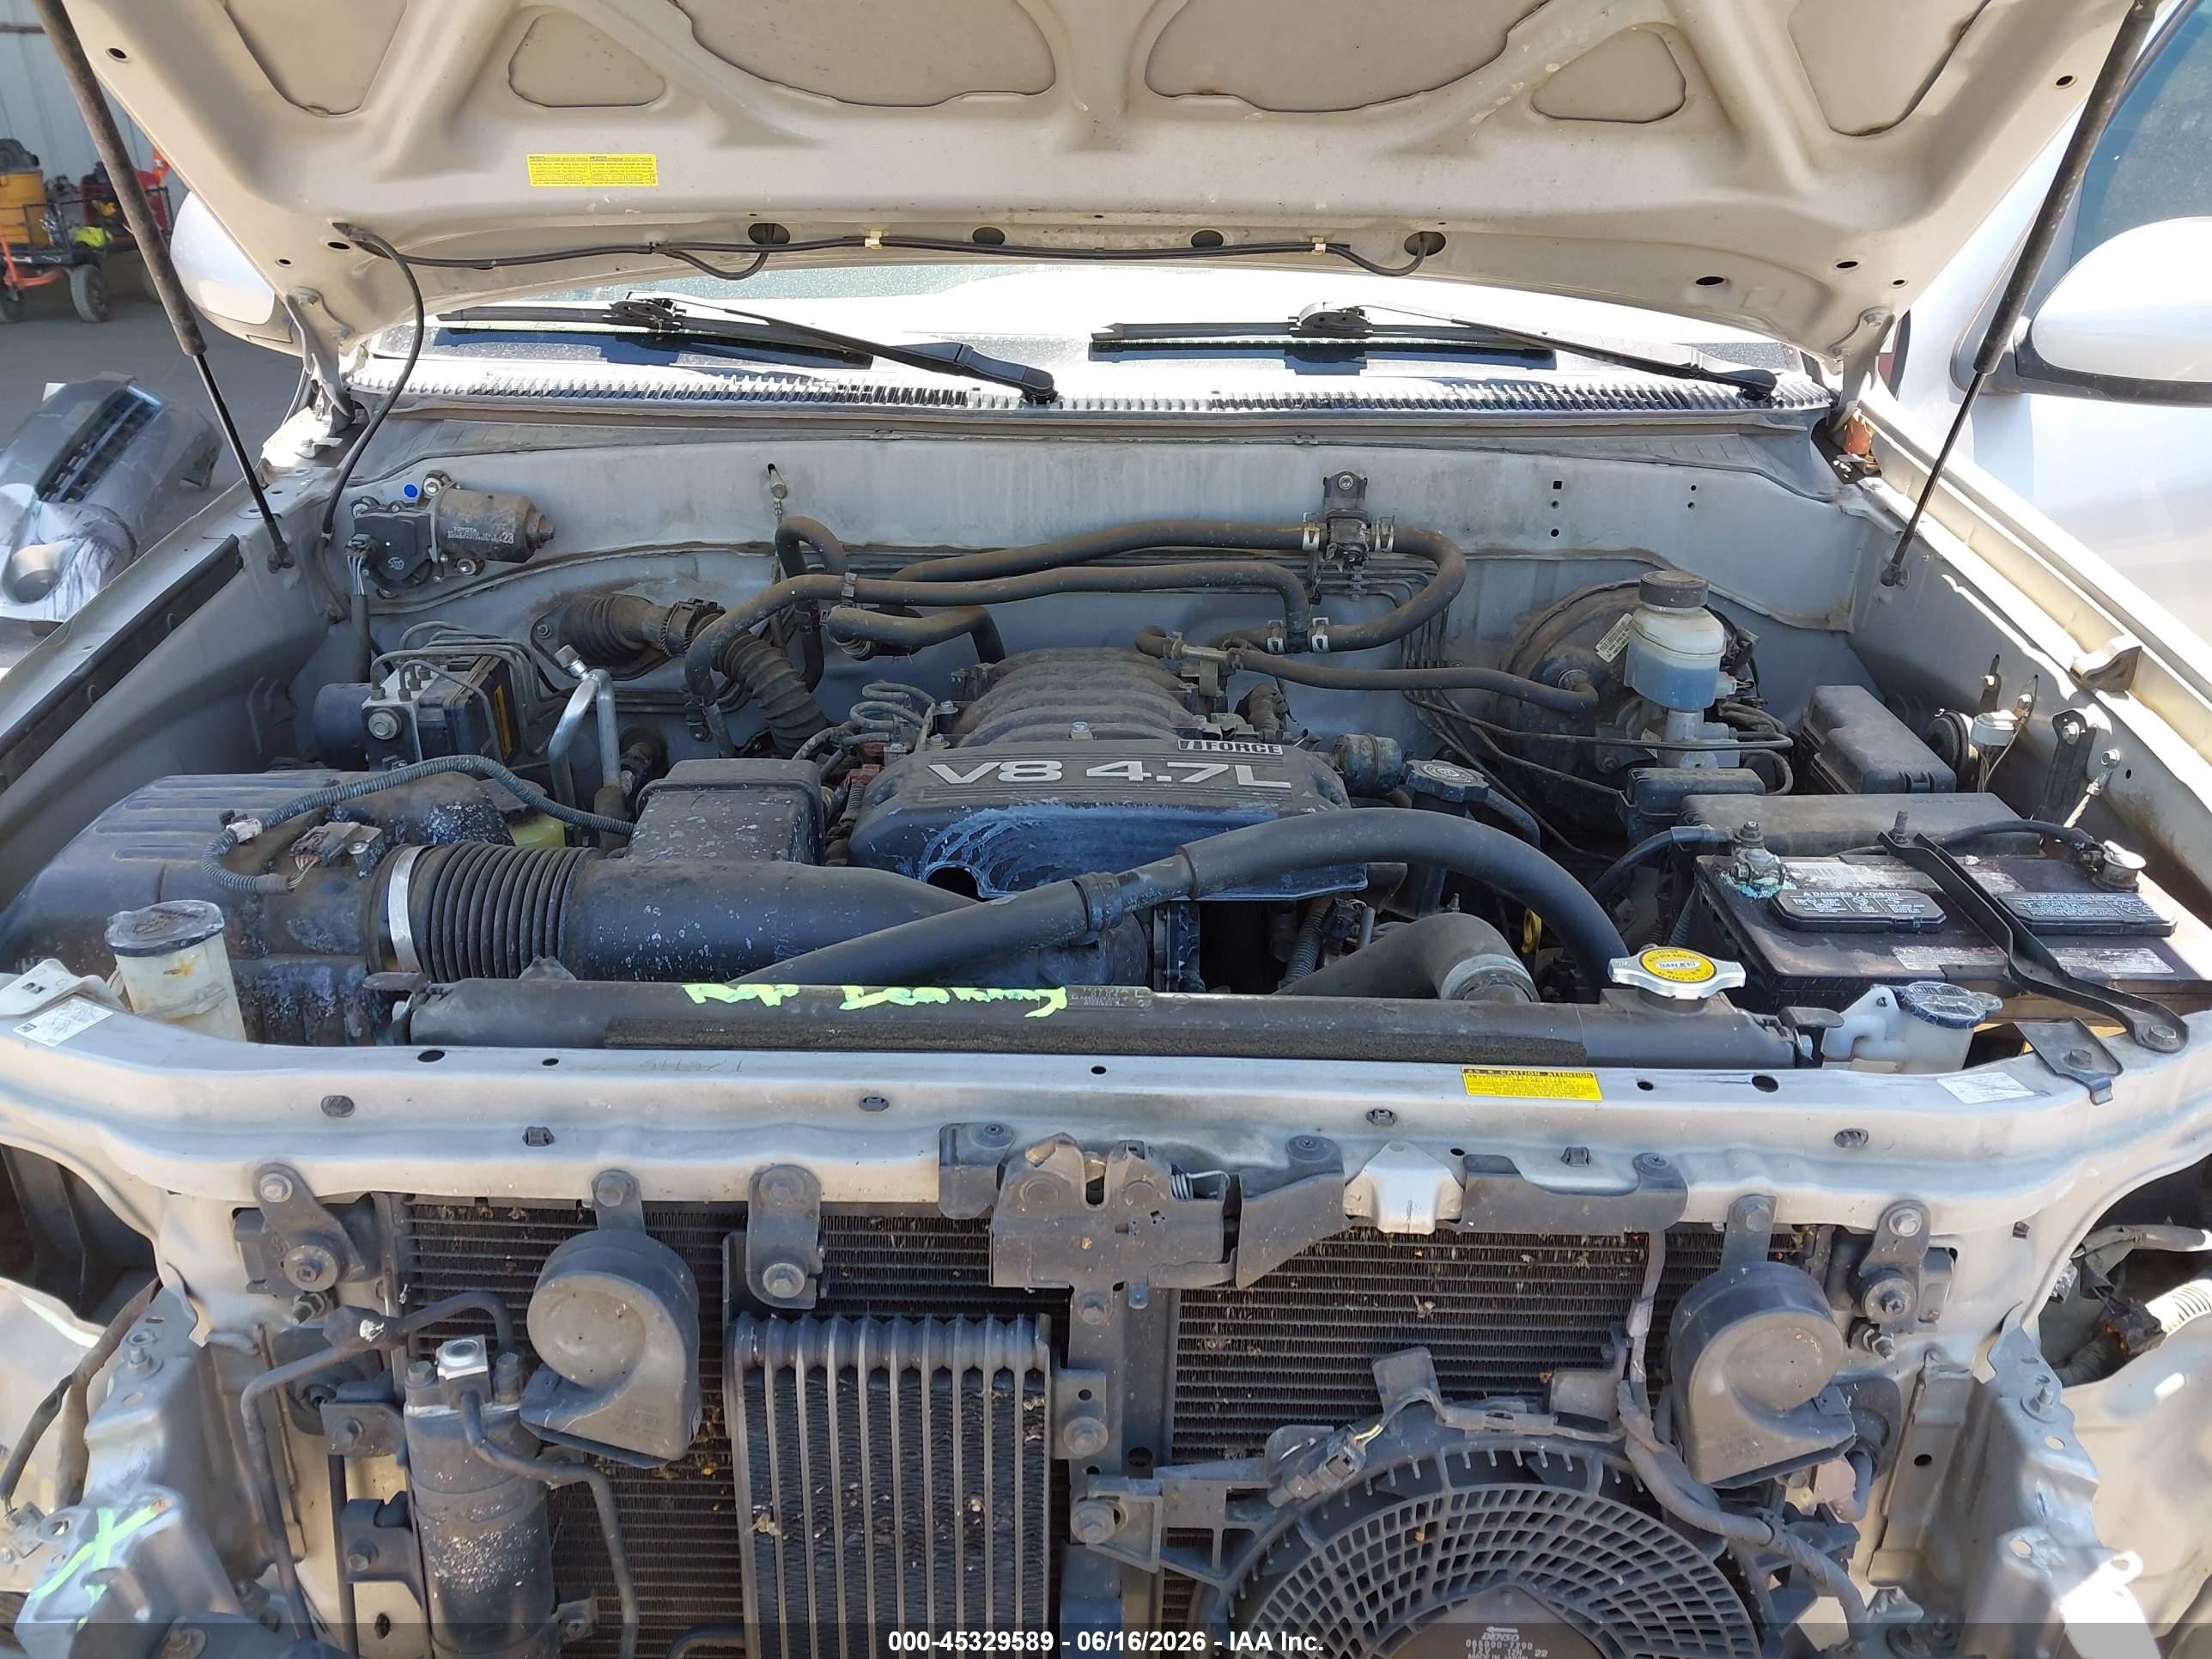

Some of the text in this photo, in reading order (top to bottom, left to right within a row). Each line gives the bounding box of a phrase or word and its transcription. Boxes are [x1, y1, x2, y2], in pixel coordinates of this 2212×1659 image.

[501, 532, 514, 544] 23
[927, 760, 1291, 788] V8 4.7L
[1481, 1632, 1520, 1642] DENSO
